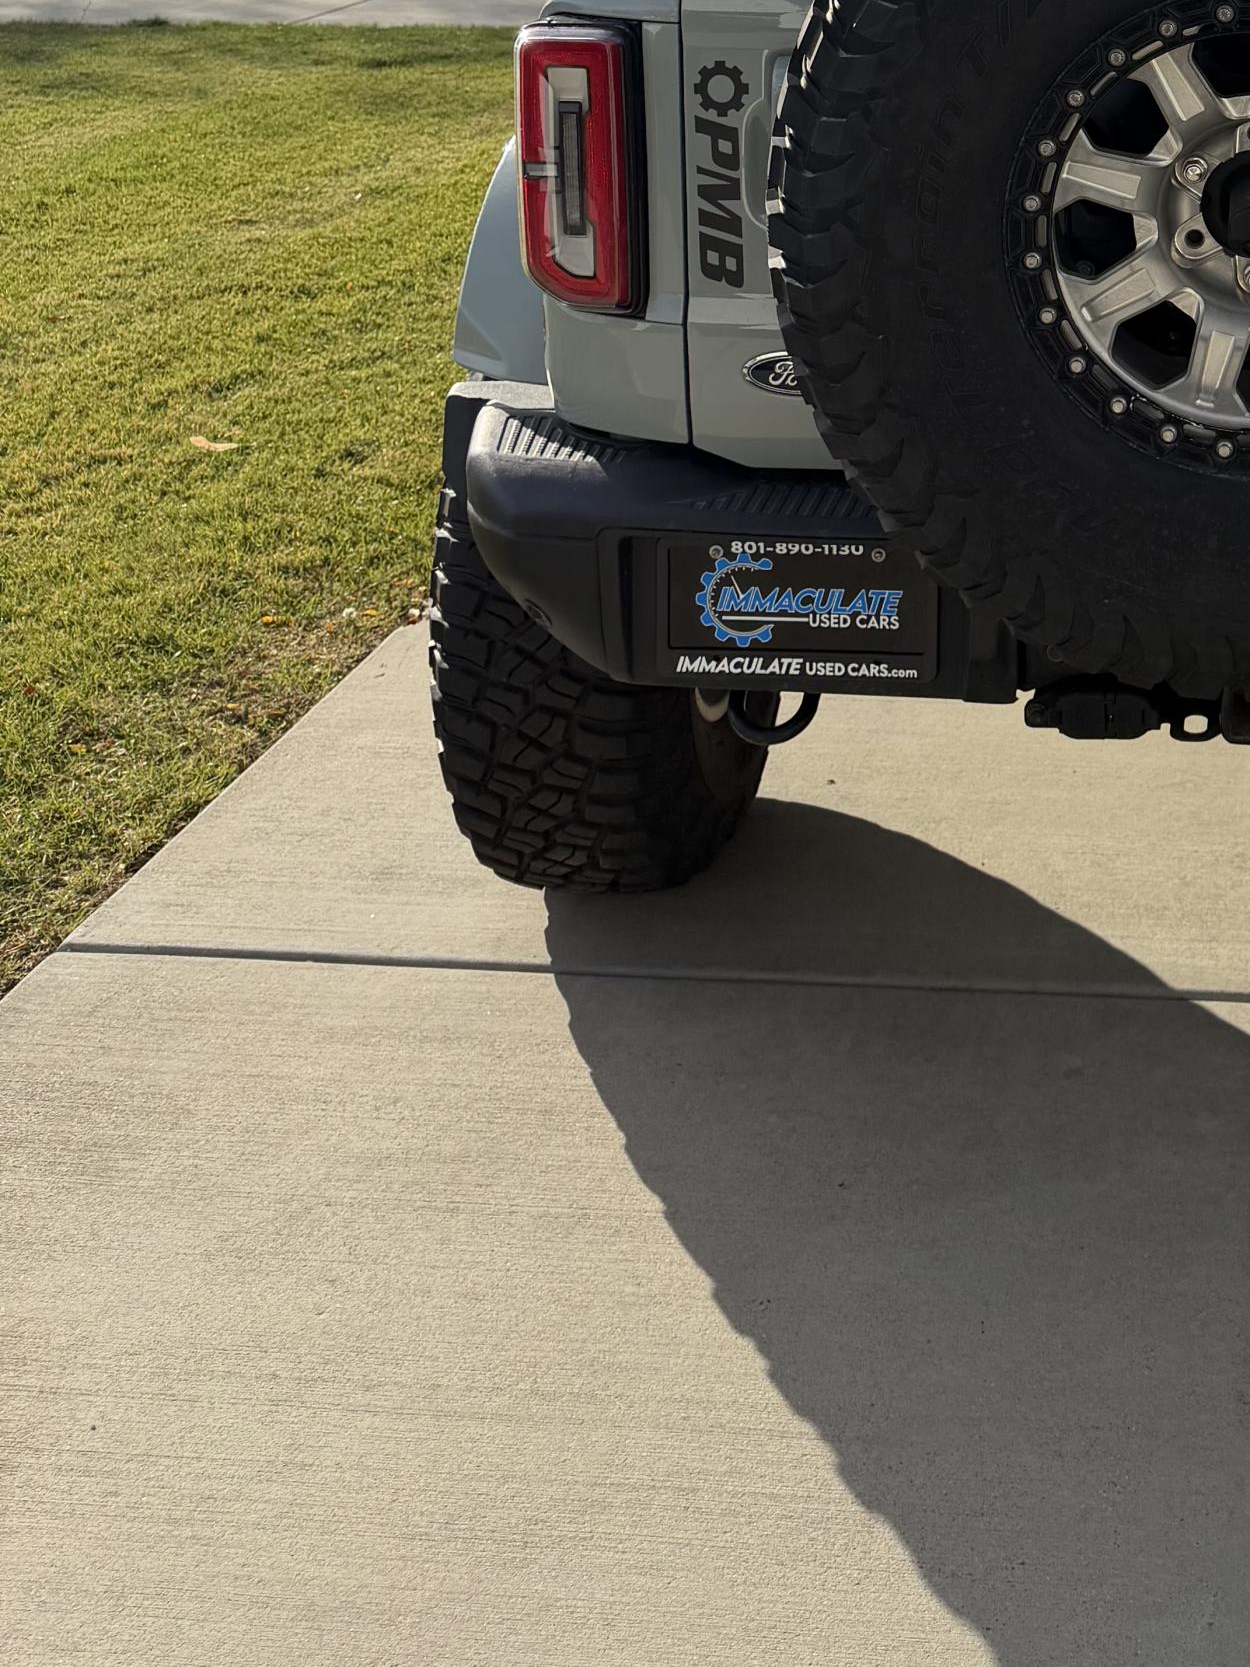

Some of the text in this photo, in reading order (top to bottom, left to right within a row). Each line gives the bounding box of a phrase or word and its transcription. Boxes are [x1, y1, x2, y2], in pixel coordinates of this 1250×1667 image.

[730, 541, 864, 555] 801-890-1130
[716, 586, 903, 616] IMMACULATE
[808, 614, 900, 630] USED CARS
[676, 656, 918, 679] IMMACULATE USED CARS.com
